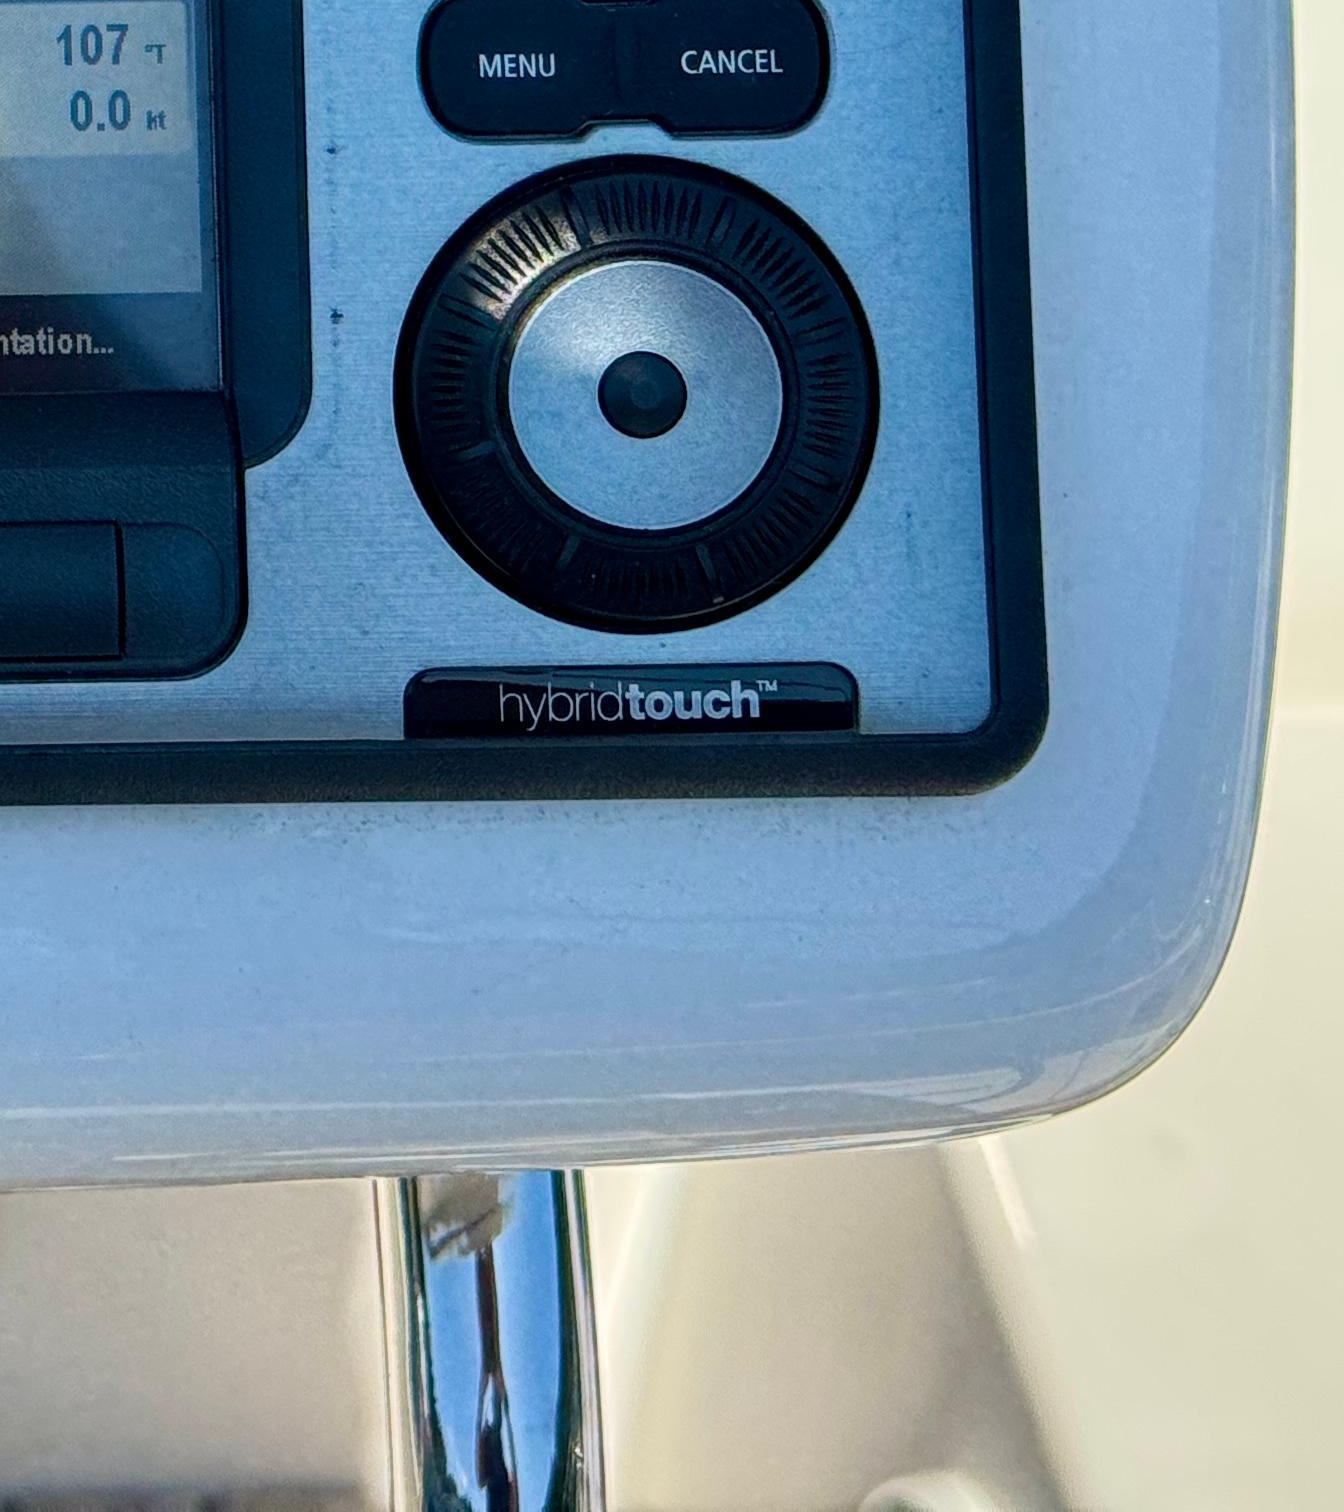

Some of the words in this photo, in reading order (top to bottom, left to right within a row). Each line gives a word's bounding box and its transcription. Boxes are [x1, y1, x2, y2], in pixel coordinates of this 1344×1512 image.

[56, 24, 129, 66] 107
[680, 48, 784, 74] CANCEL
[478, 53, 556, 79] MENU
[70, 89, 131, 132] 0.0
